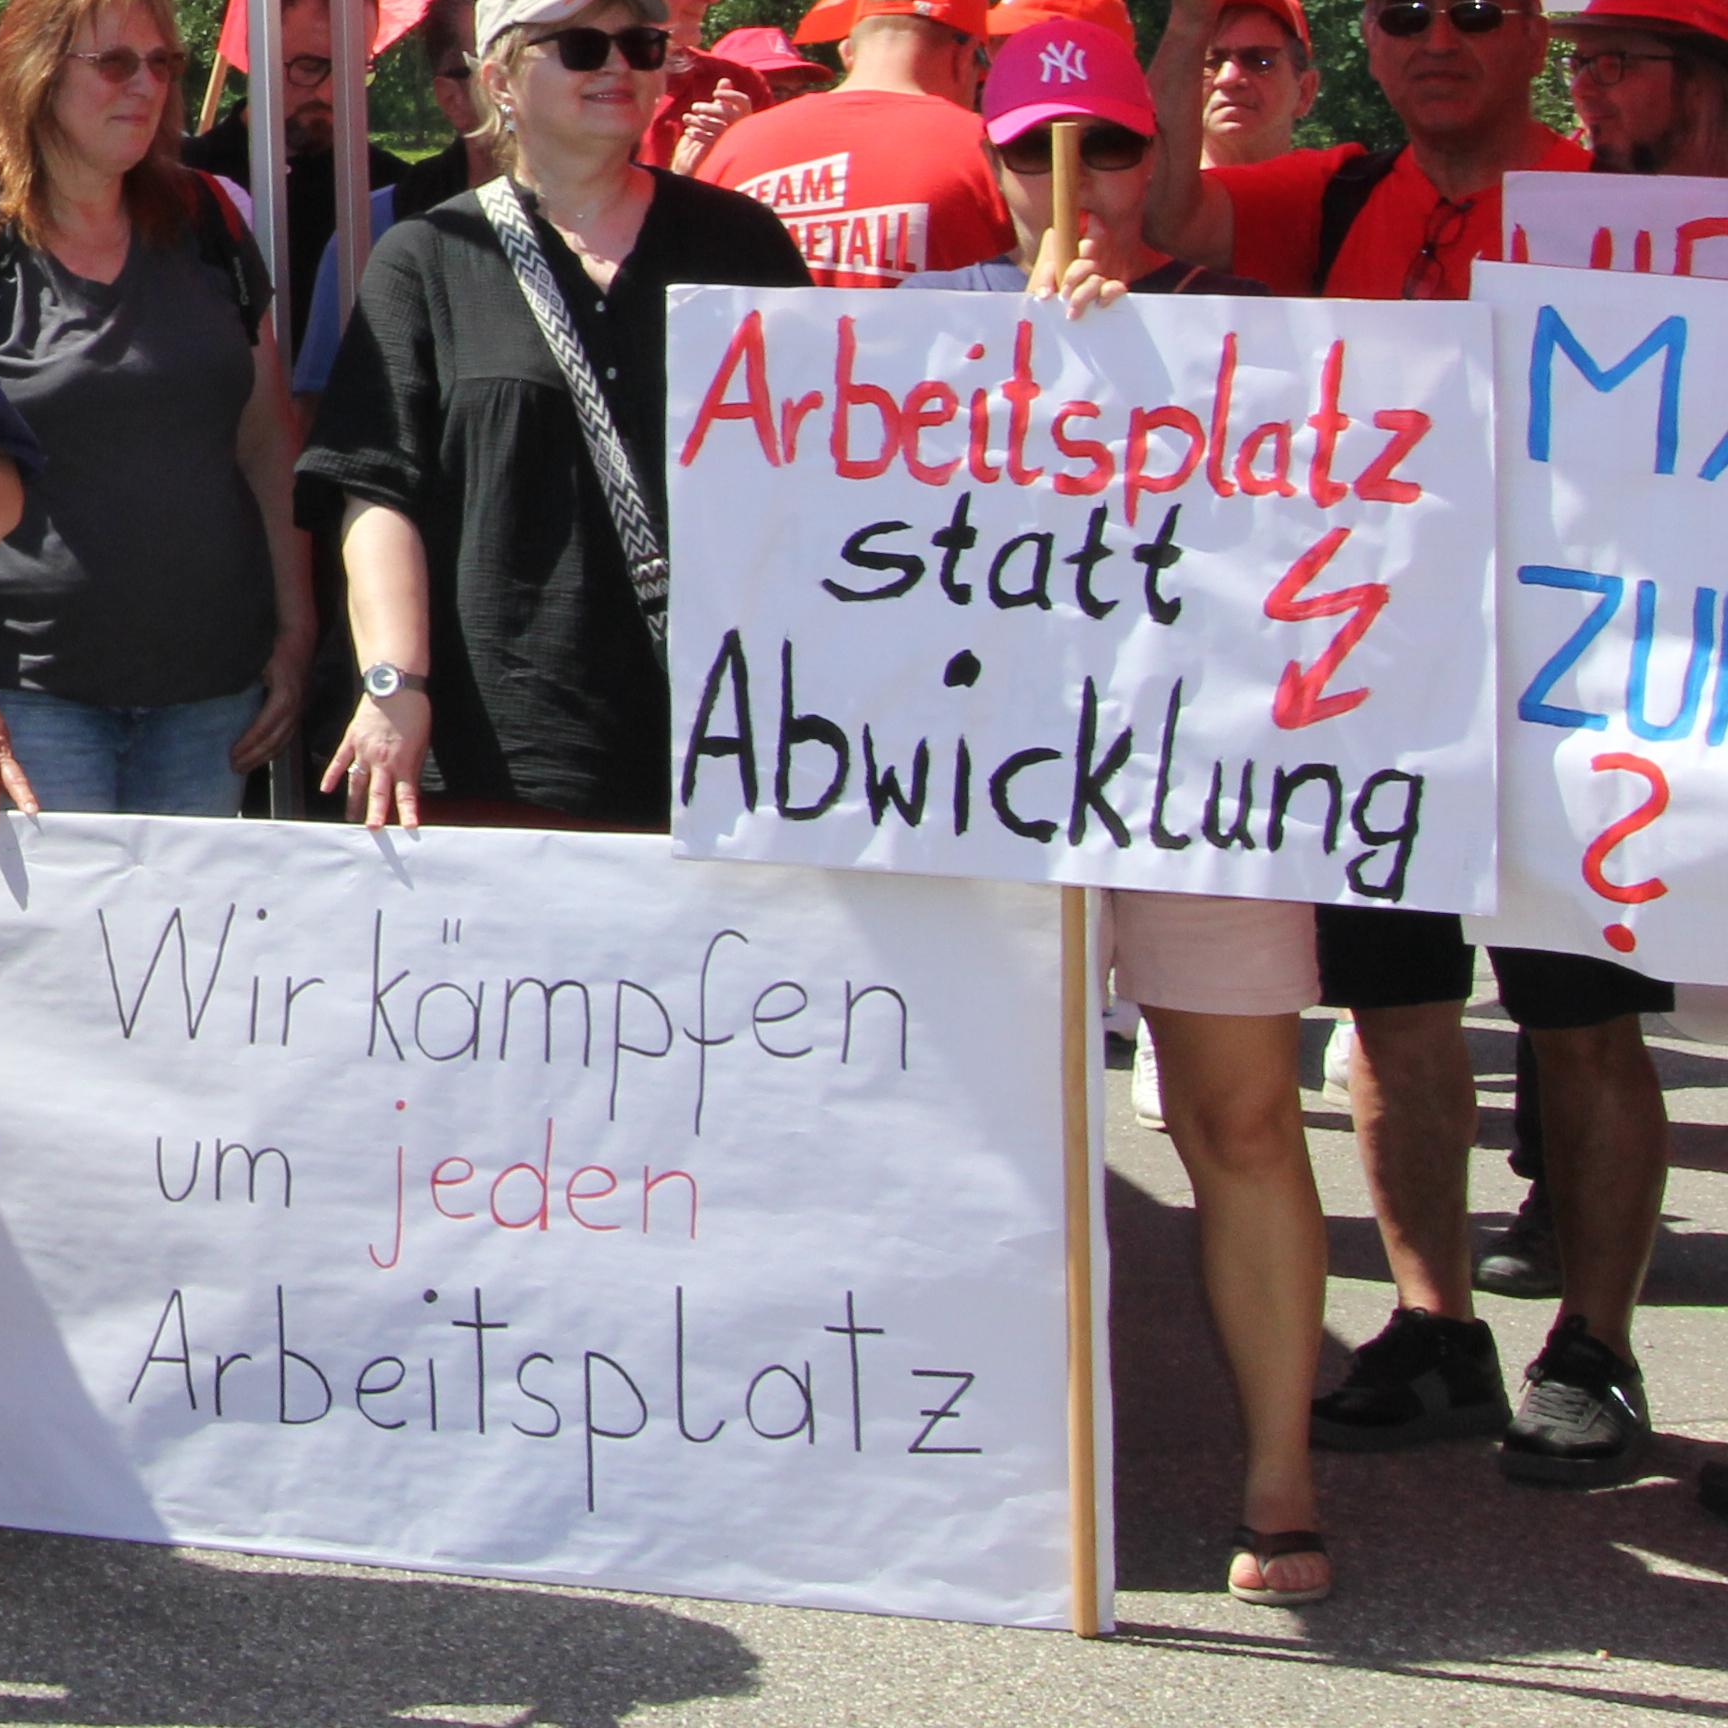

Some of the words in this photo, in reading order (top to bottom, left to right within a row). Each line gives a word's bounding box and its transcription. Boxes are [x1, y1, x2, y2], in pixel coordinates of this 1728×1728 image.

[680, 310, 1432, 527] Arbeitsplatz
[821, 492, 1182, 624] statt
[1518, 564, 1728, 747] ZU
[681, 628, 1424, 902] Abwicklung
[1583, 752, 1669, 952] ?
[98, 903, 324, 1045] Wir
[367, 909, 908, 1137] kämpfen
[155, 1136, 292, 1208] um
[368, 1100, 699, 1270] jeden
[127, 1285, 984, 1513] Arbeitsplatz
